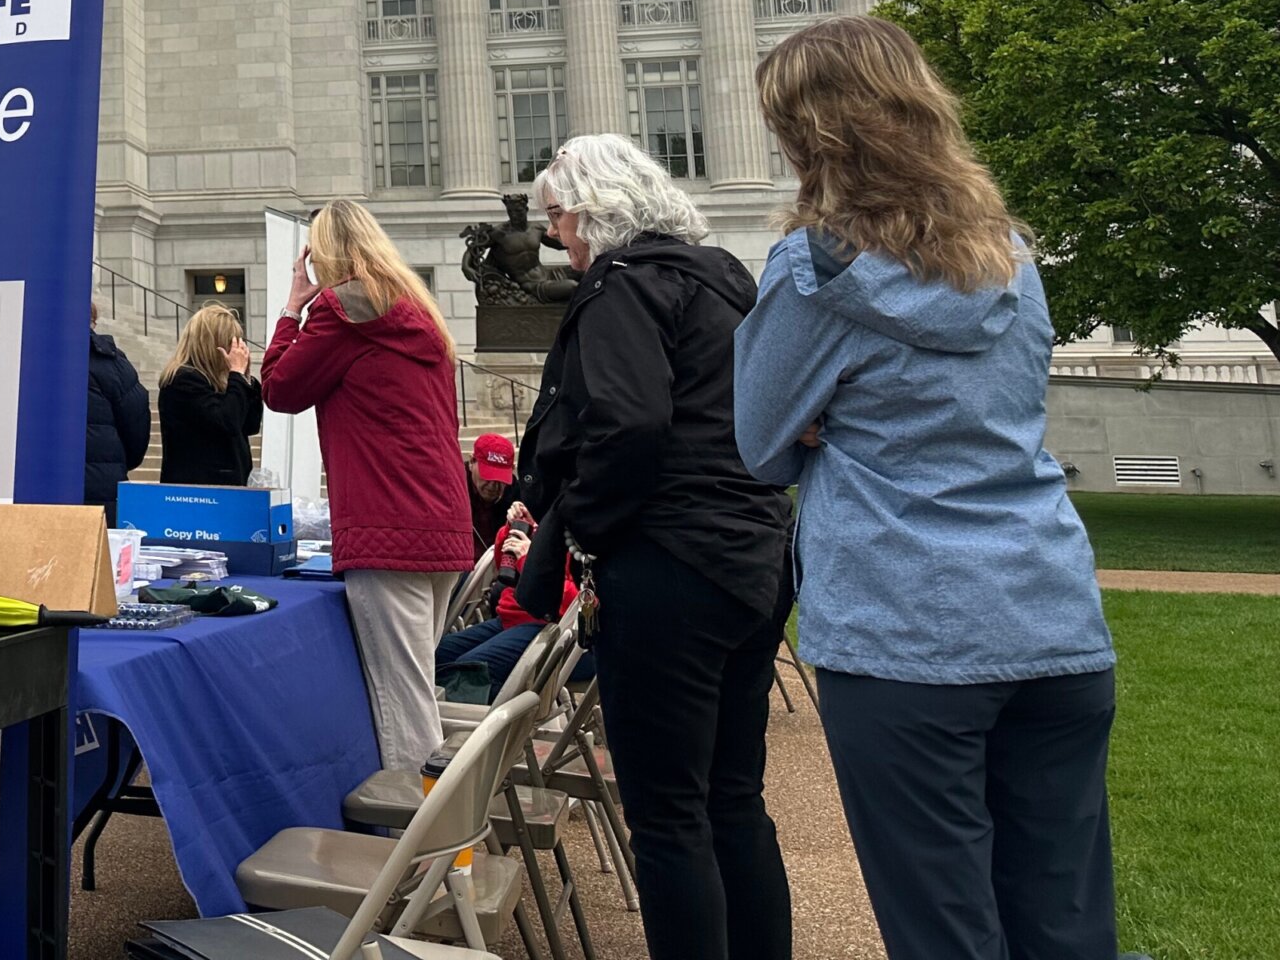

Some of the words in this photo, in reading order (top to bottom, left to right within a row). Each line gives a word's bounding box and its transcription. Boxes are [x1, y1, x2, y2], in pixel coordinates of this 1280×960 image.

[165, 495, 218, 504] HAMMERMILL
[164, 528, 193, 540] Copy
[195, 530, 220, 540] Plus
